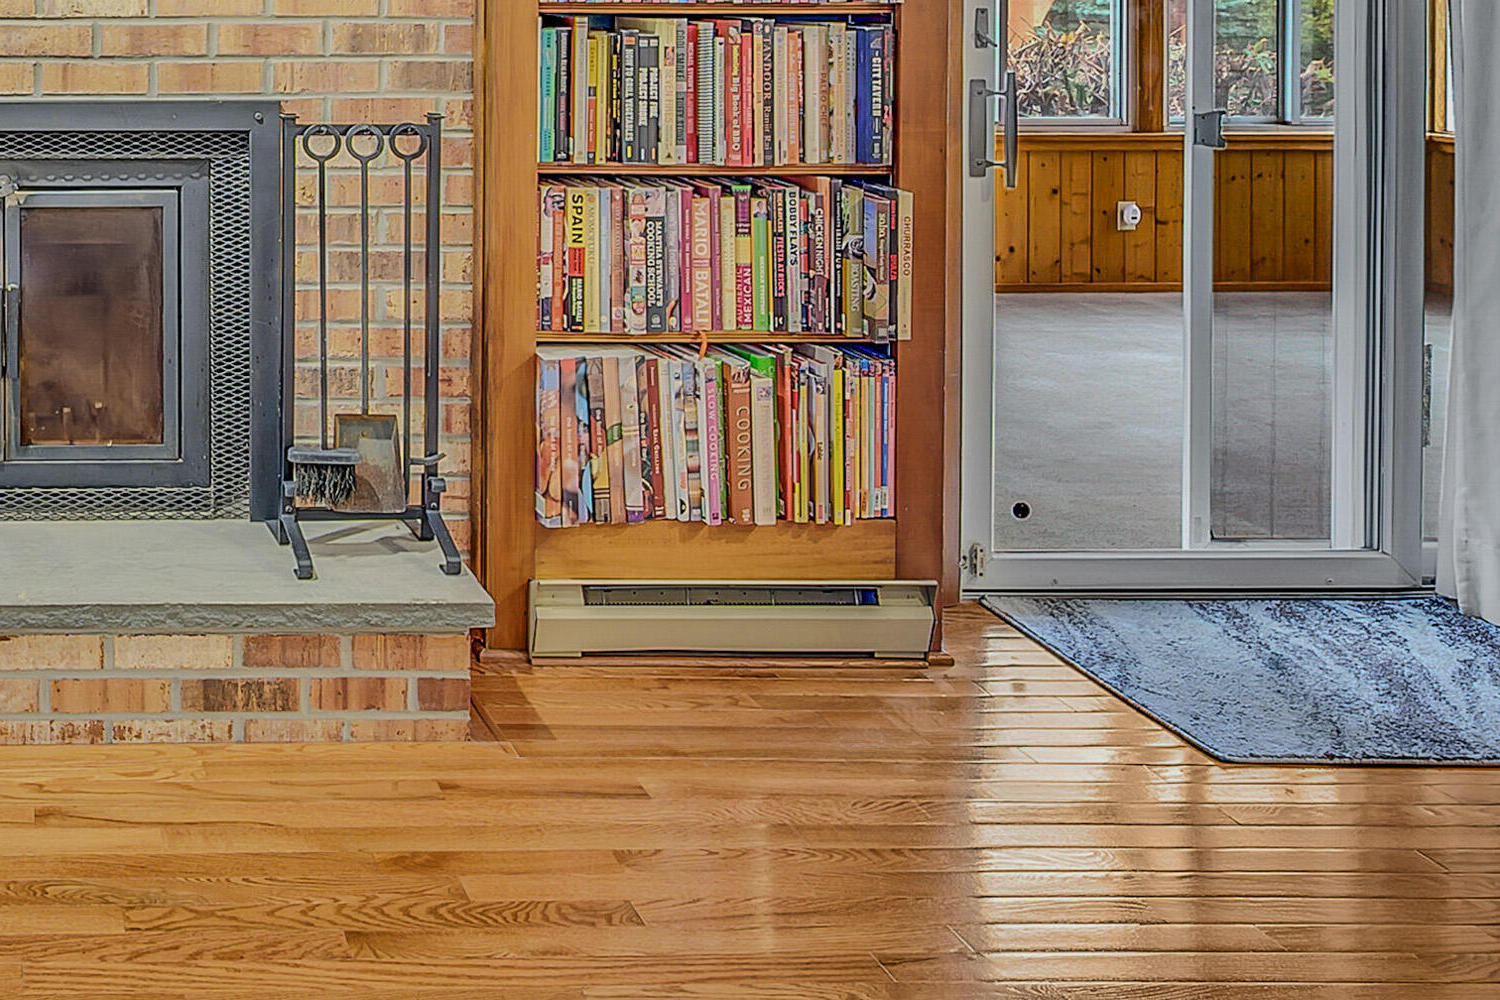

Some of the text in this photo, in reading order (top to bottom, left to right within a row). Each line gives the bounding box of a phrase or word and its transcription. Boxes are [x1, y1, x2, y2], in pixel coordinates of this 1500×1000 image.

[625, 48, 634, 142] HOW TO GRILL VEGETABLES
[639, 67, 648, 127] PROJECT SMOKE
[649, 67, 658, 119] PROJECT FIRE
[677, 29, 685, 143] COOL SMOKE TUFFY STONE
[731, 76, 740, 151] Big Book of BBQ
[763, 36, 772, 151] TANDOOR Ranjit Rai
[871, 57, 882, 117] CITY TAVERN
[571, 193, 584, 244] SPAIN
[587, 205, 595, 264] MOMOFUKU
[788, 191, 799, 266] BOBBY FLAY'S
[815, 207, 824, 276] CHICKEN NIGHT
[903, 216, 911, 277] CHURRASCO
[646, 221, 656, 307] COOKING SCHOOL
[655, 221, 663, 307] MARTHA STEWART'S
[694, 202, 708, 323] MARIO BATALI
[743, 267, 752, 323] MEXICAN
[776, 236, 785, 298] FIESTA AT RICK'S
[850, 263, 860, 312] ROASTING
[707, 388, 717, 480] SLOW COOKING
[736, 406, 750, 490] COOKING
